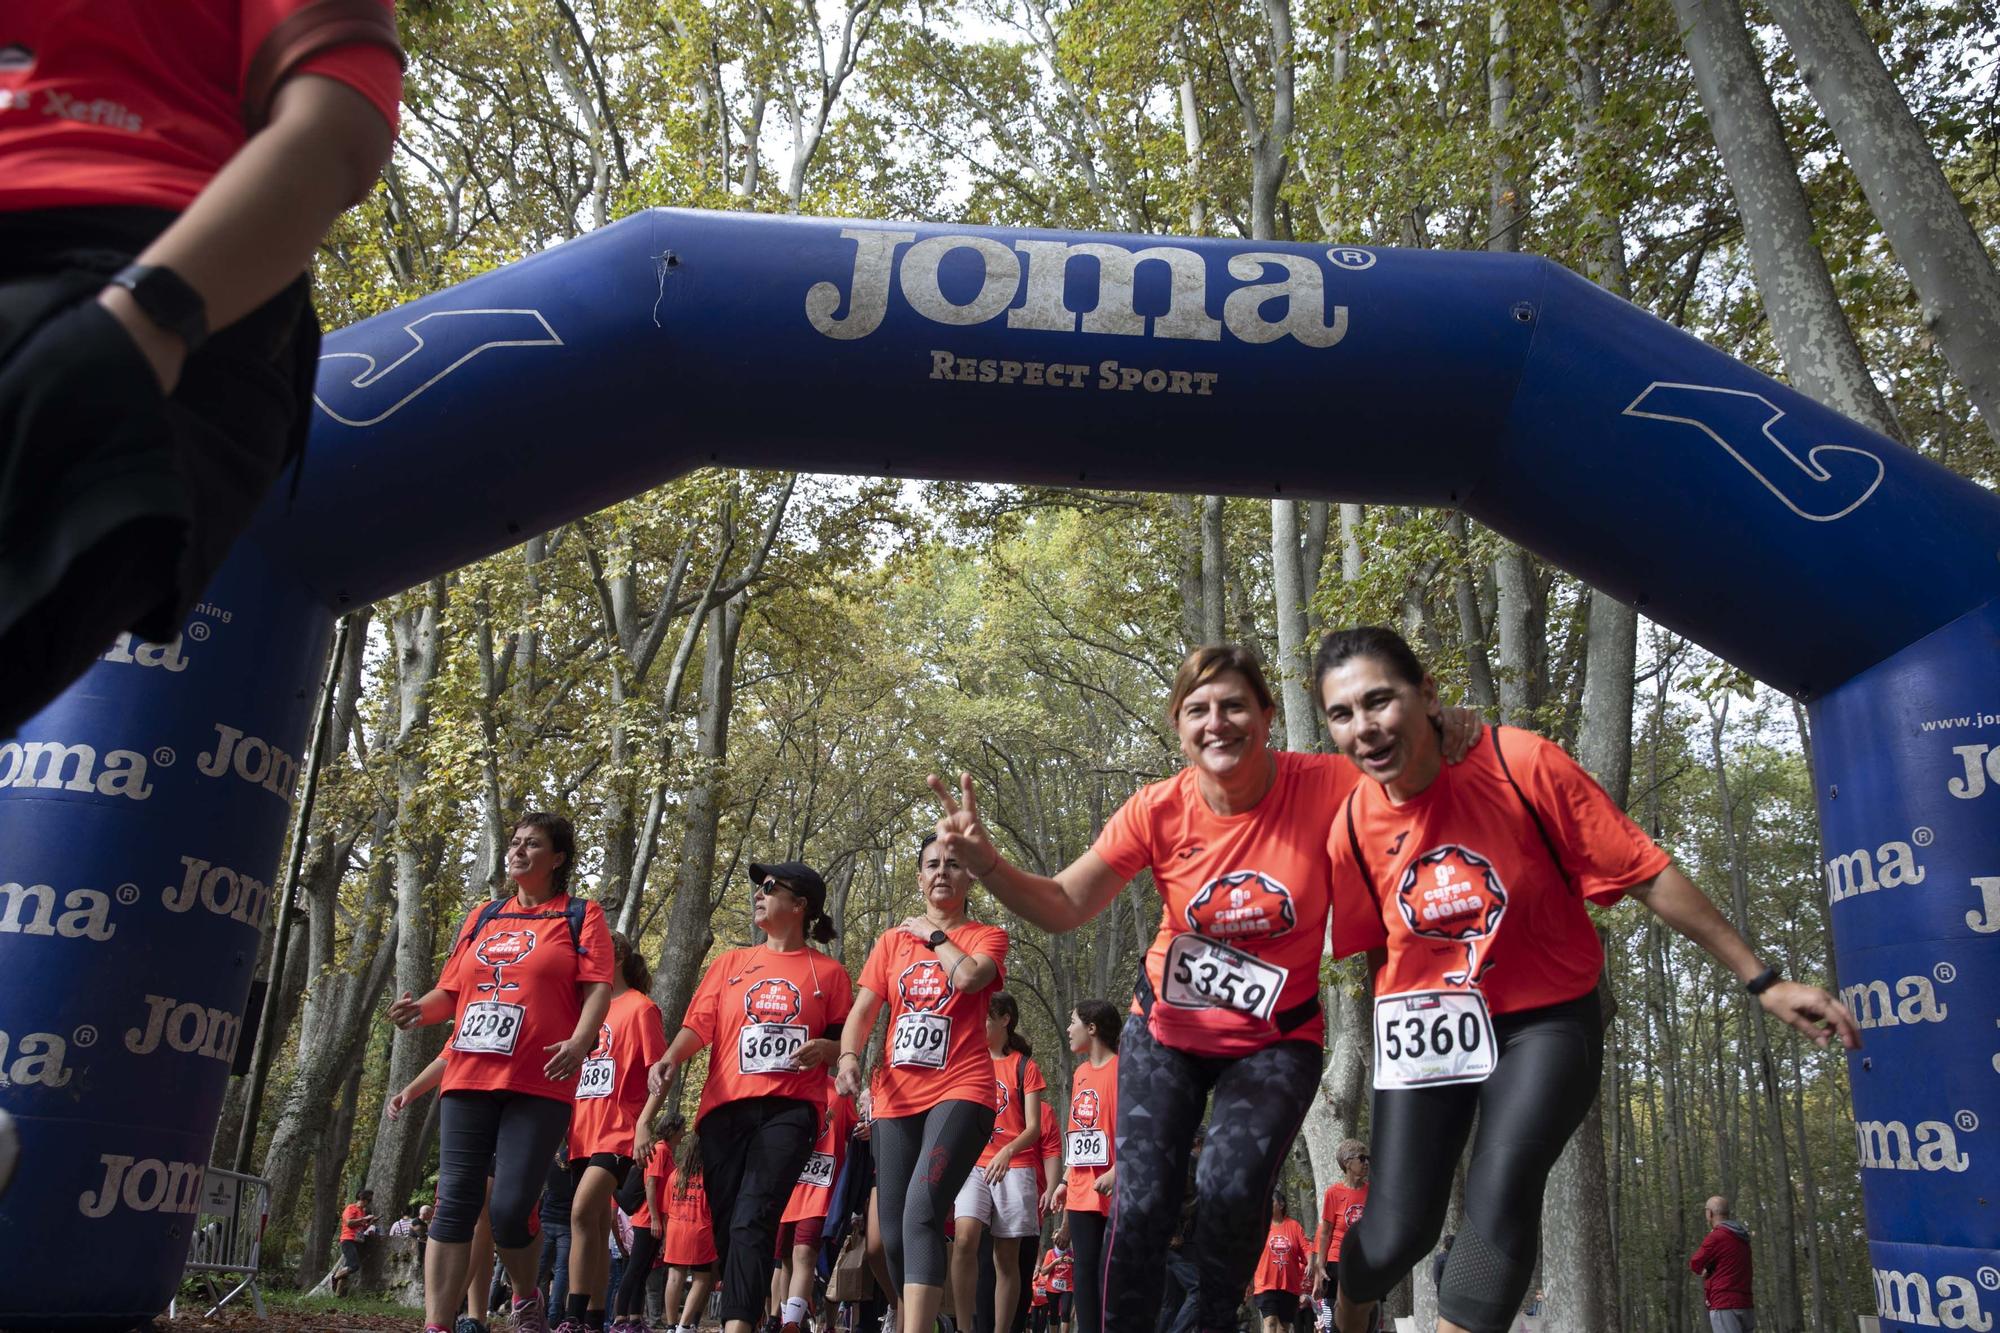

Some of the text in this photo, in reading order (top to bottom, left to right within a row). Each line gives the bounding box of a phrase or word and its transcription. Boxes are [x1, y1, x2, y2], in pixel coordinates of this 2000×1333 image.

[929, 350, 1218, 395] RESPECT SPORT
[1422, 895, 1483, 920] dona
[1210, 919, 1271, 934] dona
[909, 985, 942, 996] dona
[1174, 952, 1266, 1013] 5359
[755, 1000, 788, 1011] dona
[462, 1014, 515, 1038] 3298
[1386, 1011, 1481, 1061] 5360
[895, 1026, 943, 1051] 2509
[580, 1067, 611, 1087] 689
[1074, 1137, 1101, 1156] 396
